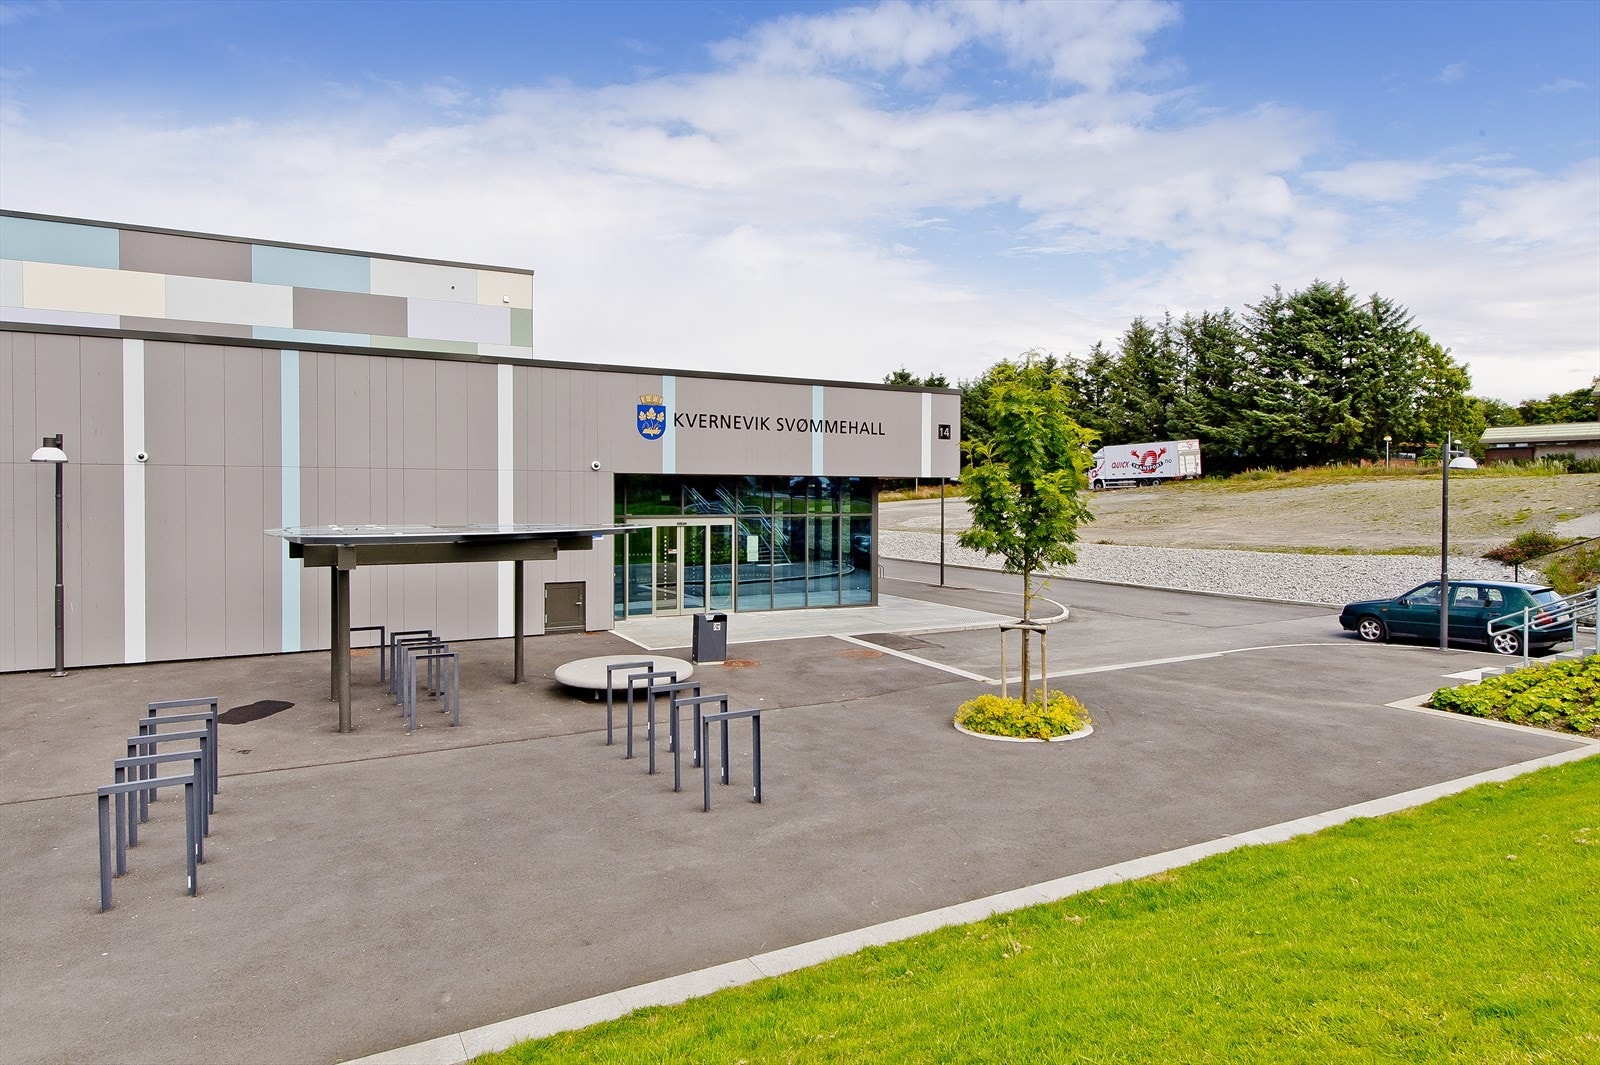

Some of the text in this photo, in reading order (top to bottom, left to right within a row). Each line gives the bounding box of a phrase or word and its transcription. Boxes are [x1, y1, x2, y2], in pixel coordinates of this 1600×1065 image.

[673, 412, 886, 436] KVERNEVIK SVØMMEHALL
[939, 426, 950, 438] 14
[1111, 461, 1129, 469] QUICK
[1132, 461, 1163, 471] TRANSPORT
